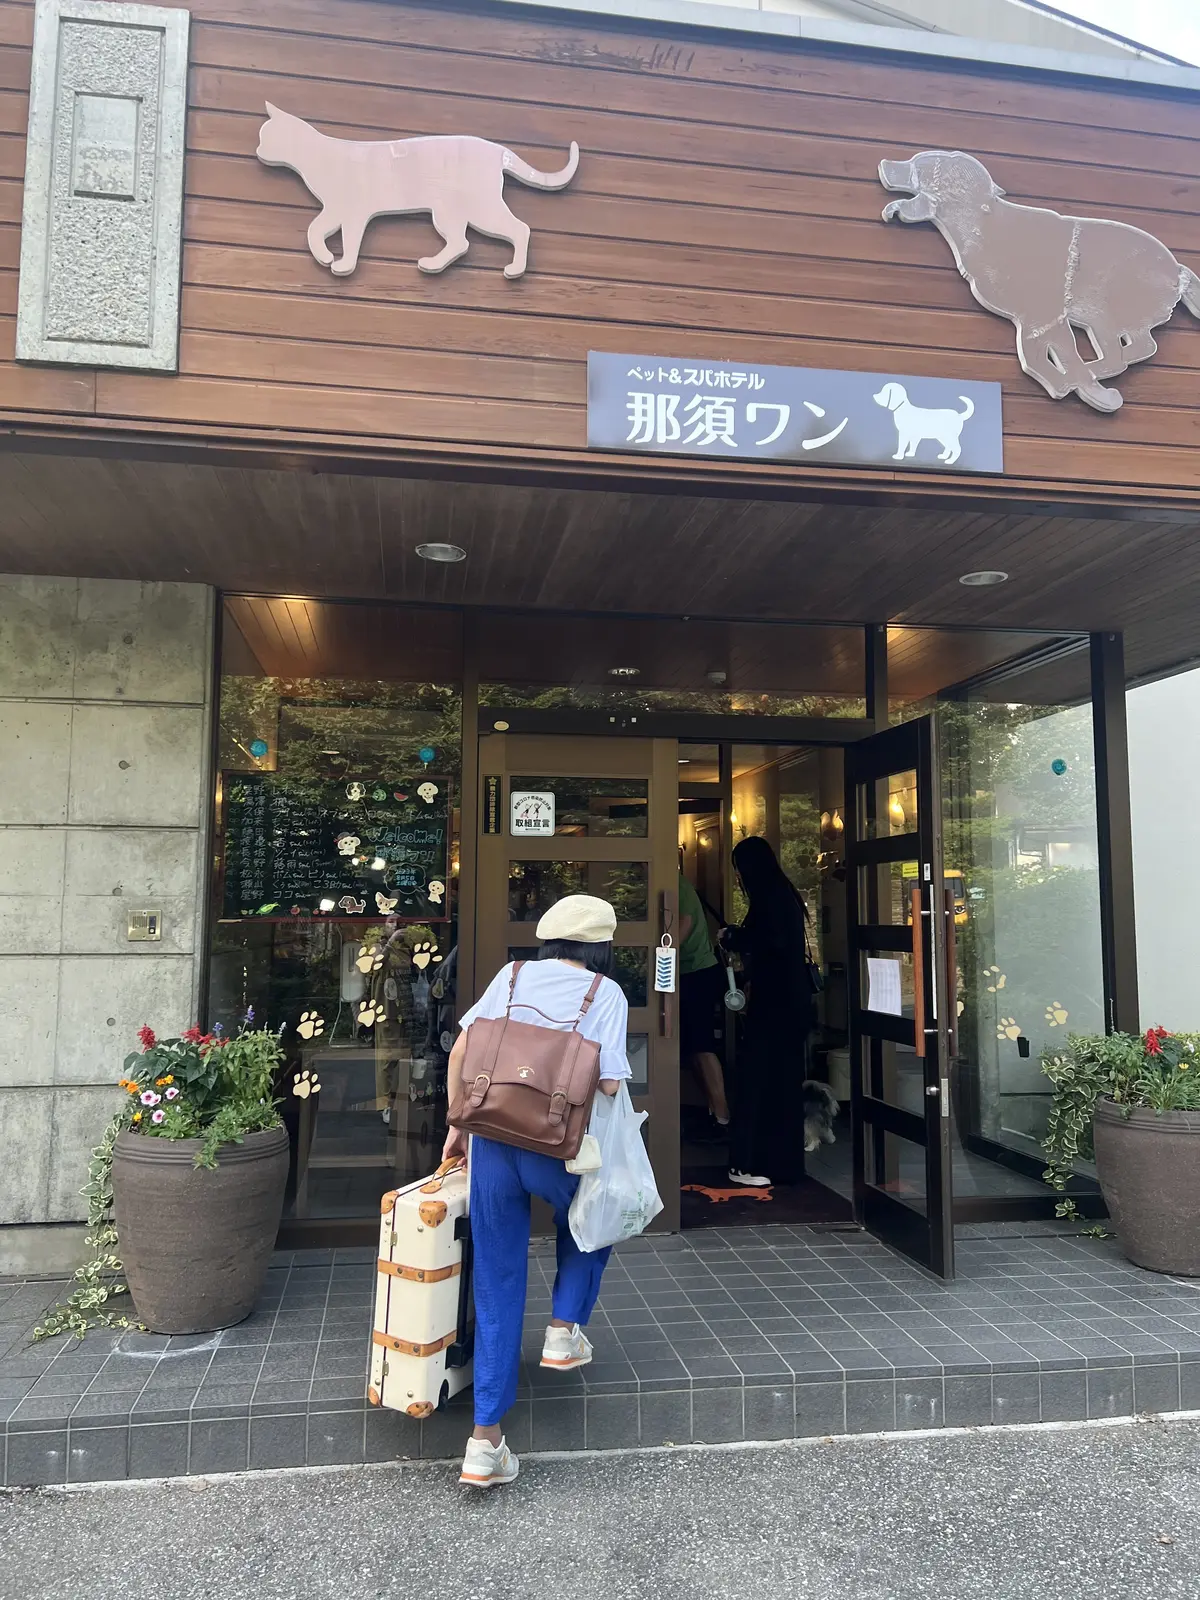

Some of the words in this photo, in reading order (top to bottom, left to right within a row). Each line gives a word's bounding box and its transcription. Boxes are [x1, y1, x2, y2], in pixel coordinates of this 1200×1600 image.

[626, 366, 765, 390] ペット&スパホテル
[625, 391, 849, 451] 那須ワン
[515, 818, 550, 828] 取組宣言
